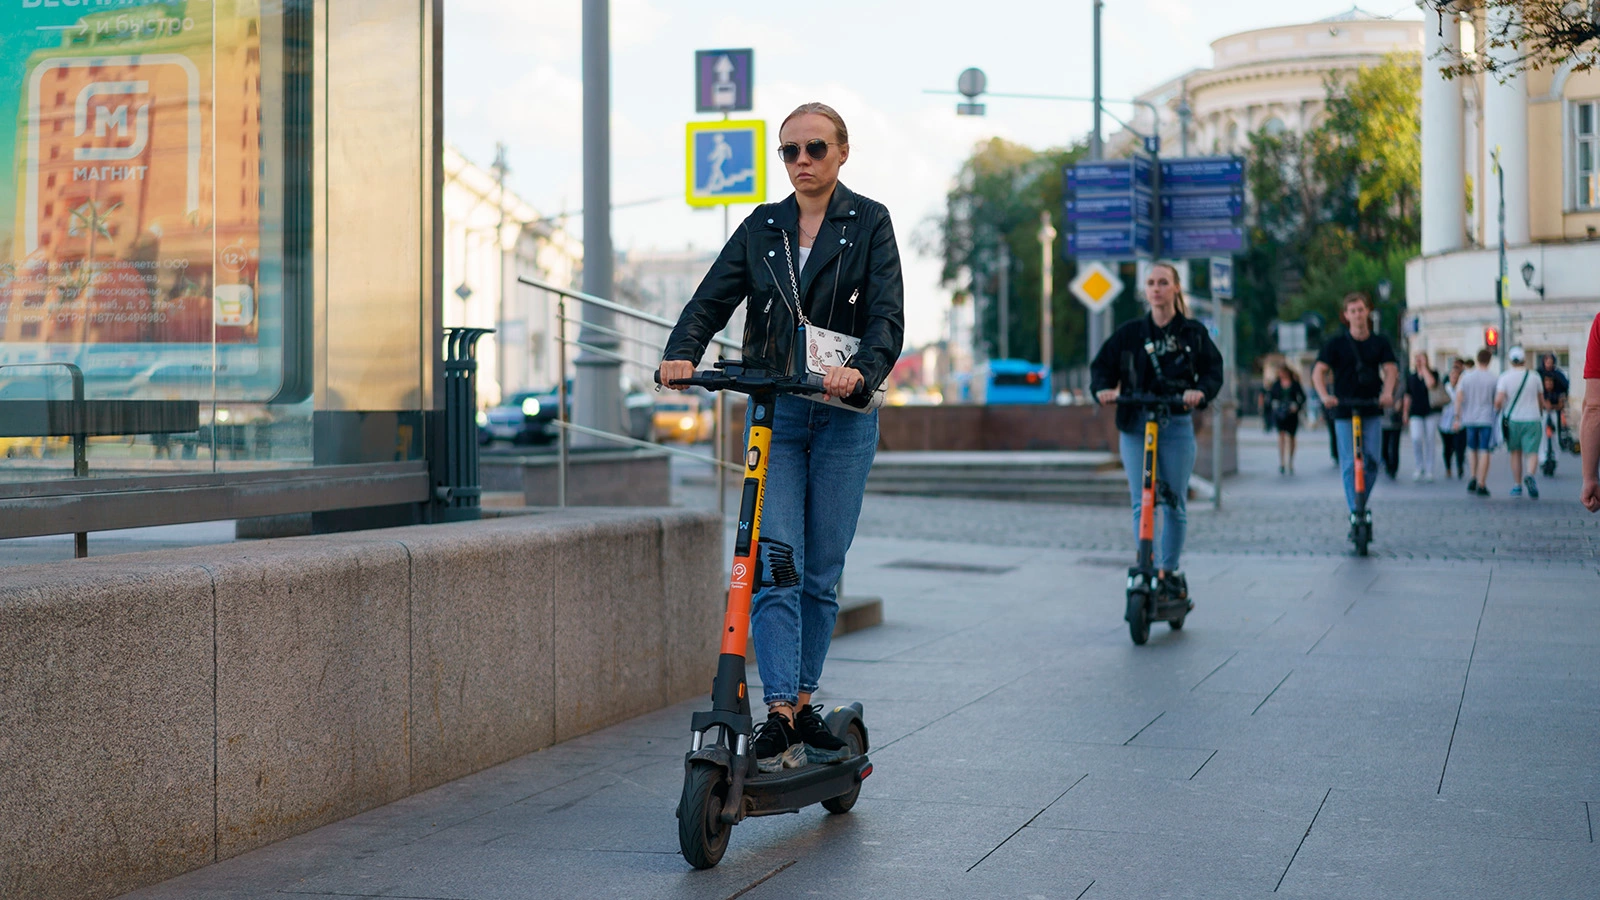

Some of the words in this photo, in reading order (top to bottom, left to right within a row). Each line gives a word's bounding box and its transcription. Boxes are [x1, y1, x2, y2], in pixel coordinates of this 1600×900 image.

[96, 23, 109, 34] и
[115, 14, 195, 36] быстро
[73, 166, 148, 181] МАГНИТ
[163, 258, 189, 269] ООО
[224, 253, 245, 265] 12+
[118, 272, 161, 284] Москва,
